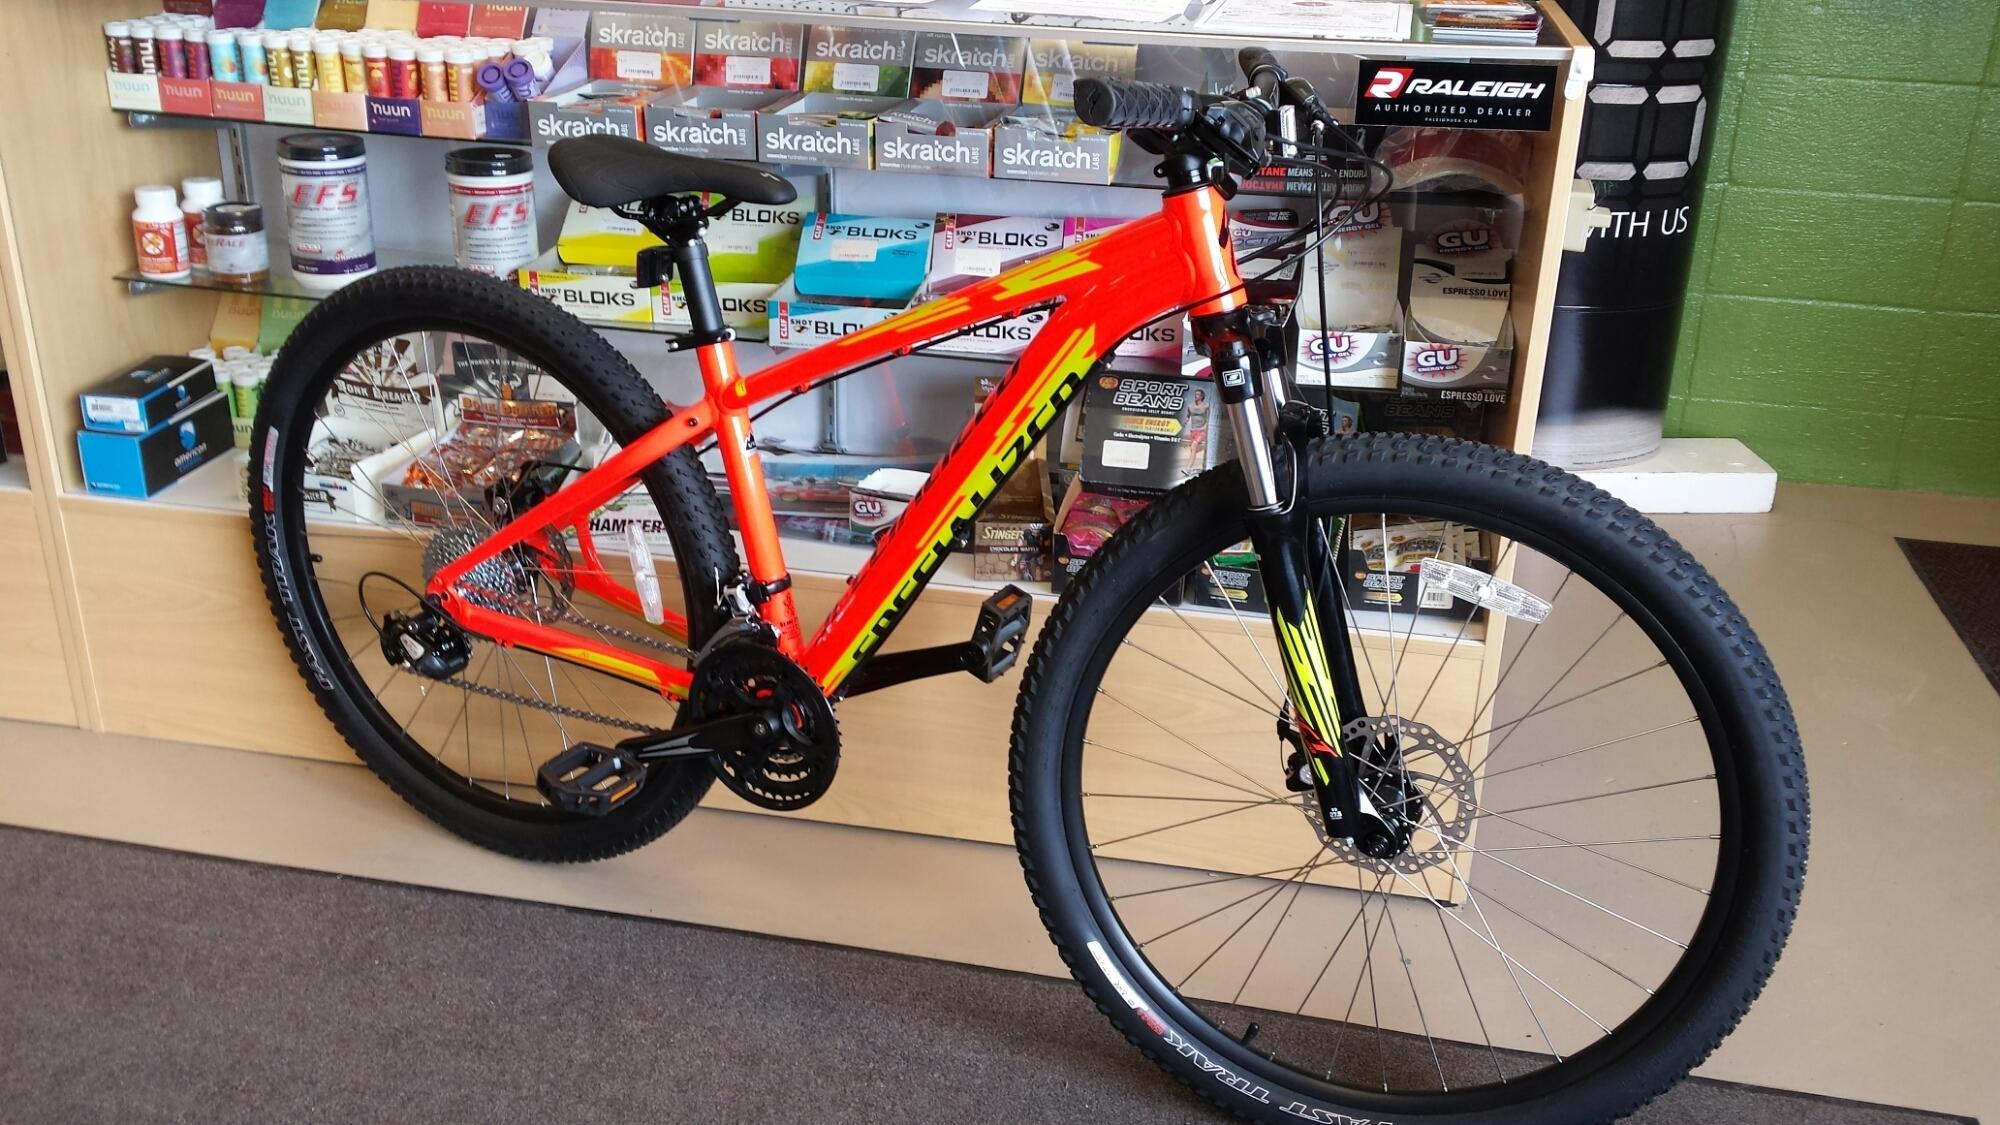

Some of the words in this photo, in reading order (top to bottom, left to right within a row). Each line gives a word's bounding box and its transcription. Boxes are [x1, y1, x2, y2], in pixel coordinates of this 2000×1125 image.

[598, 22, 677, 48] skratch
[704, 28, 784, 53] skratch
[815, 39, 896, 61] skratch
[164, 83, 202, 97] nuun
[215, 88, 255, 102] nuun
[1405, 78, 1547, 100] RALEIGH
[371, 102, 411, 118] nuun
[1374, 103, 1467, 115] AUTHORIZED
[1477, 107, 1532, 118] DEALER
[653, 120, 738, 145] skratch
[766, 127, 852, 154] skratch
[883, 136, 970, 164] skratch
[970, 146, 980, 164] LABS
[1002, 142, 1091, 169] skratch
[1091, 152, 1101, 170] LABS
[1288, 166, 1314, 177] MEANS
[291, 181, 360, 206] EFS
[463, 202, 530, 226] EFS
[731, 208, 800, 225] BLOKS
[1661, 206, 1690, 235] US
[813, 225, 822, 240] CLIF
[846, 226, 918, 241] BLOKS
[1336, 225, 1364, 233] NERGY
[945, 230, 954, 249] CLIF
[977, 231, 1048, 248] BLOKS
[1438, 230, 1489, 248] GU
[563, 289, 635, 307] BLOKS
[1442, 287, 1486, 296] ESPRESSO
[1487, 288, 1509, 298] LOVE
[662, 294, 672, 315] CLIF
[720, 297, 767, 313] OKS
[780, 319, 789, 338] CLIF
[790, 318, 813, 326] SHOT
[814, 321, 864, 336] BLO
[1416, 349, 1458, 367] GU
[334, 379, 369, 399] BONK
[1119, 378, 1189, 396] SPORT
[1112, 391, 1184, 410] BEANS
[1440, 390, 1483, 401] ESPRESSO
[1485, 394, 1507, 404] LOVE
[854, 500, 881, 514] GU
[589, 518, 662, 533] HAMER
[982, 526, 1025, 541] STINGER
[1163, 1029, 1271, 1105] TRAK
[1278, 1101, 1394, 1125] AST
